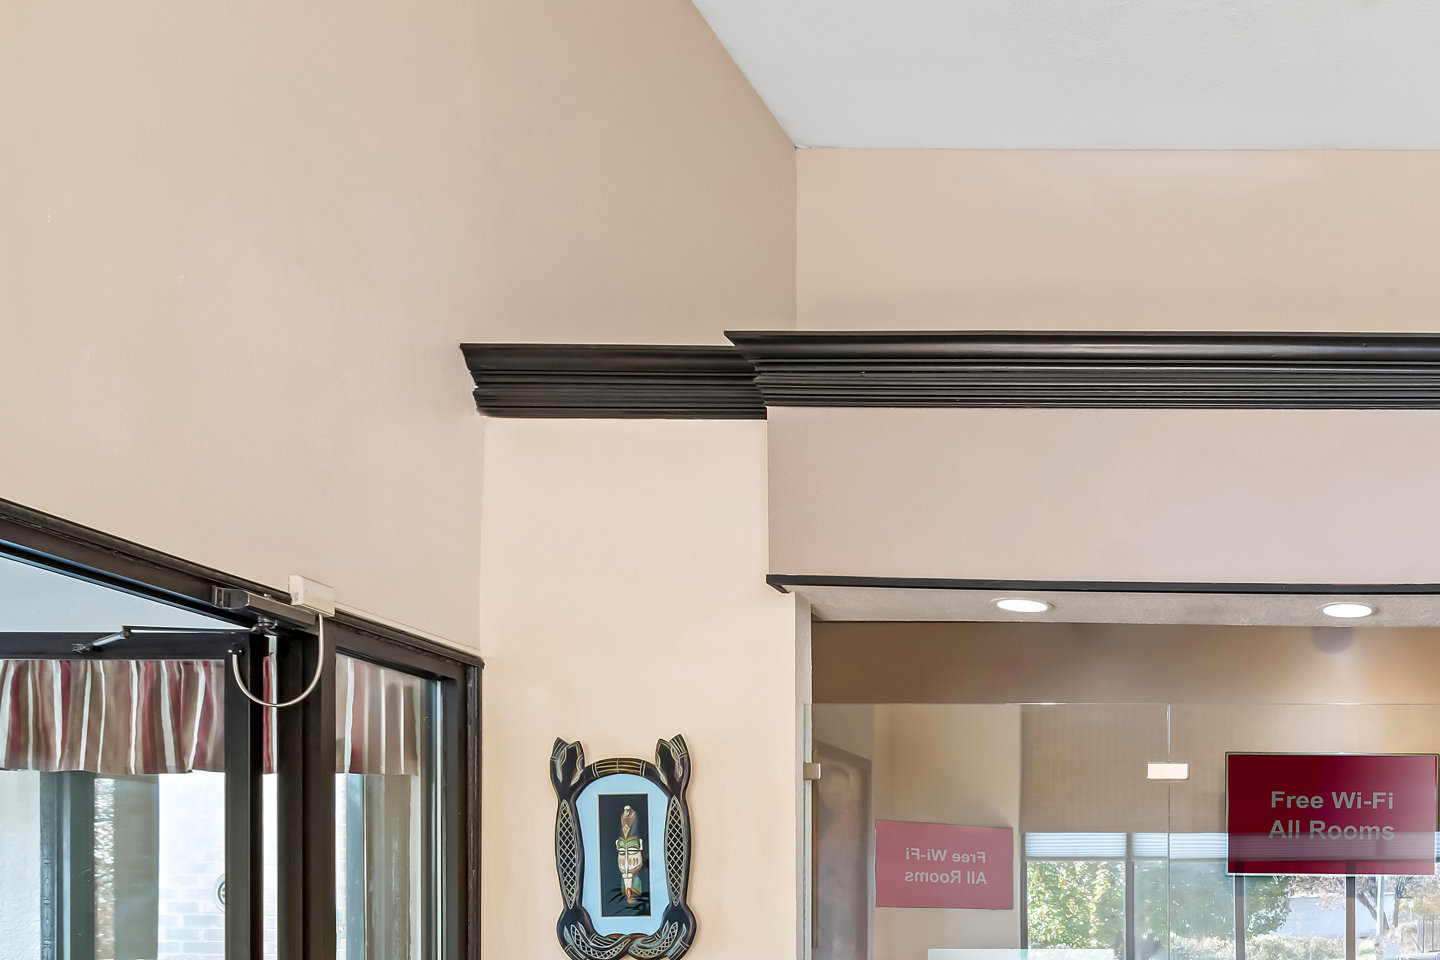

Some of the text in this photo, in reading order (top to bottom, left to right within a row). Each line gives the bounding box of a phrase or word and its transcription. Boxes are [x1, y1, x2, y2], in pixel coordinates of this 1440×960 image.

[1271, 790, 1394, 810] Free Wi-Fi
[1268, 819, 1395, 841] All Rooms
